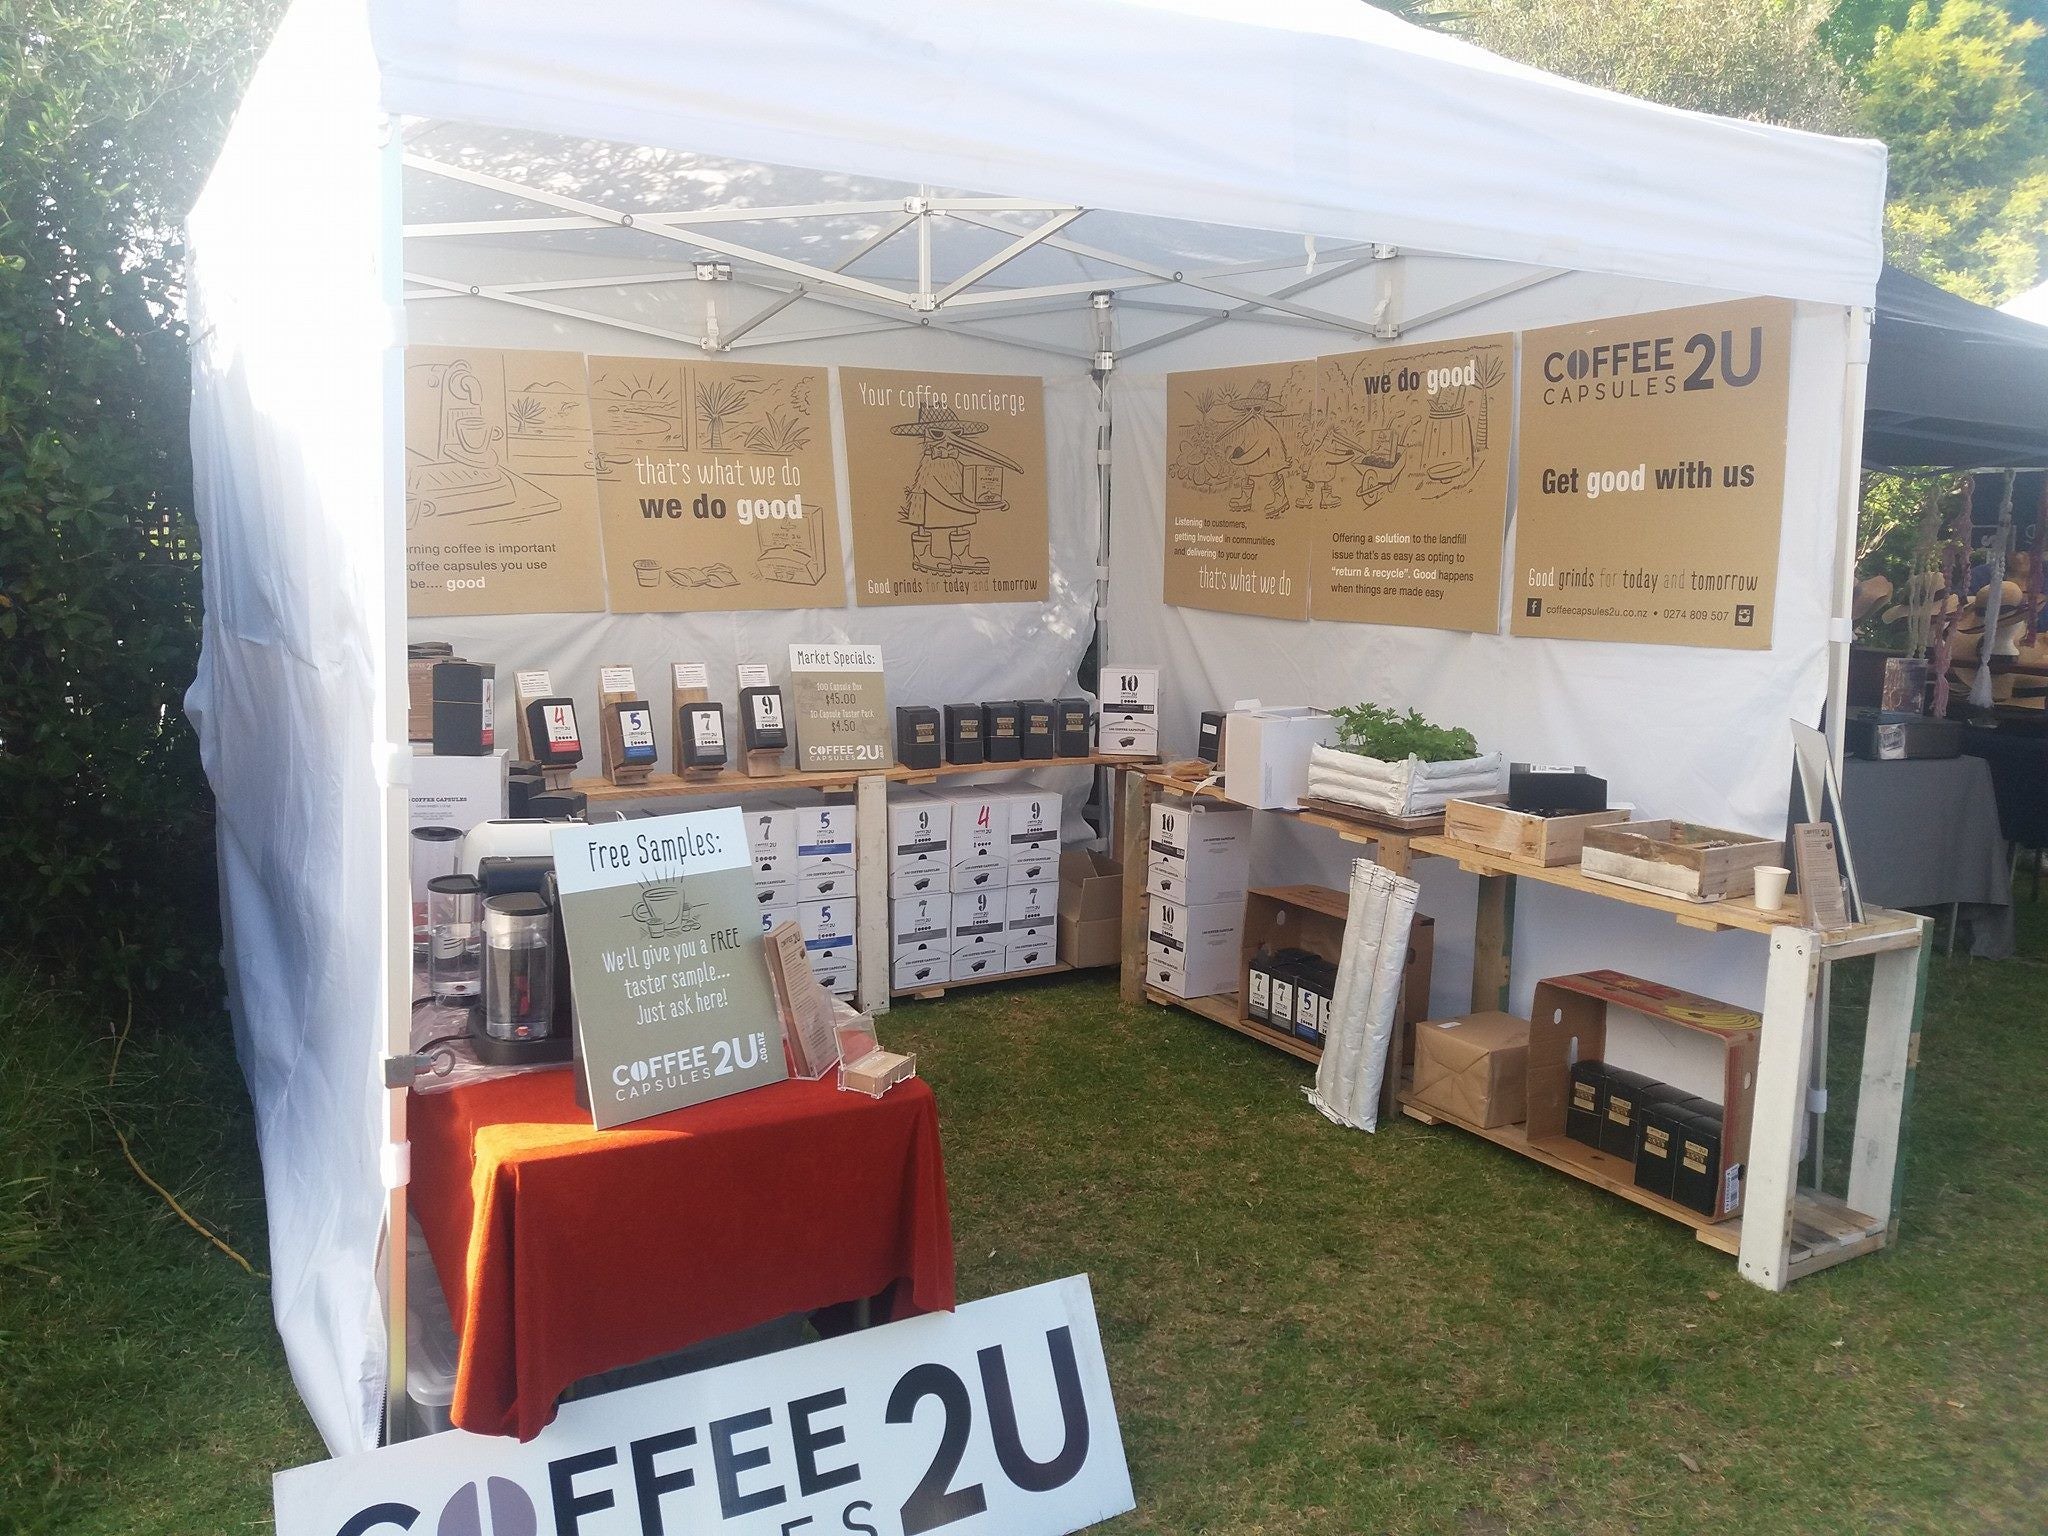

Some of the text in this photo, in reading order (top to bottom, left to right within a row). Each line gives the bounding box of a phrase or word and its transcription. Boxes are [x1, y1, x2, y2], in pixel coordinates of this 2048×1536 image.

[1543, 326, 1763, 392] COFFEE 2U
[1364, 360, 1475, 395] we do good
[859, 382, 1025, 416] Your coffee concierge
[1543, 375, 1676, 406] CAPSULES
[635, 455, 800, 486] that's what we do
[1542, 461, 1755, 499] Get good with us
[639, 493, 803, 525] we do good
[1174, 517, 1247, 530] Listening to customers,
[1174, 533, 1196, 543] getting
[1225, 535, 1231, 543] in
[1232, 536, 1276, 546] communities
[1332, 532, 1467, 545] Offering a solution to the landfill
[406, 543, 556, 556] rning coffee is important
[1174, 547, 1258, 561] and delivering to your door
[1332, 550, 1465, 564] issue that's as easy as opting to
[443, 561, 497, 572] capsules
[501, 562, 523, 572] you
[527, 561, 548, 570] use
[1364, 567, 1370, 577] &
[1413, 568, 1437, 580] Good
[1438, 570, 1474, 583] happens
[446, 576, 486, 591] good
[868, 578, 1038, 596] Good grinds for today and tomorrow
[1200, 564, 1291, 596] that's what we do
[1528, 567, 1758, 594] Good grinds for today and tomorrow
[1331, 583, 1445, 600] when things are made easy
[1546, 604, 1729, 621] coffeecapsules2u.co.nz 0274 809 507
[797, 650, 876, 666] Market Specials:
[1120, 675, 1139, 691] 10
[761, 695, 773, 715] 9
[826, 692, 856, 706] $45.00
[554, 706, 565, 726] 4
[629, 712, 641, 731] 5
[701, 713, 711, 730] 7
[832, 720, 855, 733] $4.50
[809, 745, 854, 755] COFFEE
[856, 744, 879, 760] 2U
[977, 805, 990, 828] 4
[1031, 802, 1041, 819] 9
[760, 816, 772, 840] 7
[820, 812, 830, 829] 5
[919, 811, 929, 829] 9
[1162, 813, 1174, 832] 10
[589, 826, 722, 872] Free Samples:
[977, 894, 987, 911] 9
[1029, 887, 1038, 904] 7
[821, 906, 831, 923] 5
[919, 899, 928, 917] 7
[1162, 905, 1174, 924] 10
[762, 913, 772, 931] 5
[602, 927, 741, 973] We'll give you a FREE
[624, 961, 731, 999] taster sample...
[1255, 973, 1263, 992] 7
[1278, 983, 1286, 1002] 7
[1303, 992, 1312, 1010] 5
[637, 988, 729, 1025] Just ask here!
[612, 1033, 759, 1086] COFFEE 2U
[615, 1067, 711, 1102] CAPSULES
[885, 1325, 1091, 1536] 2U
